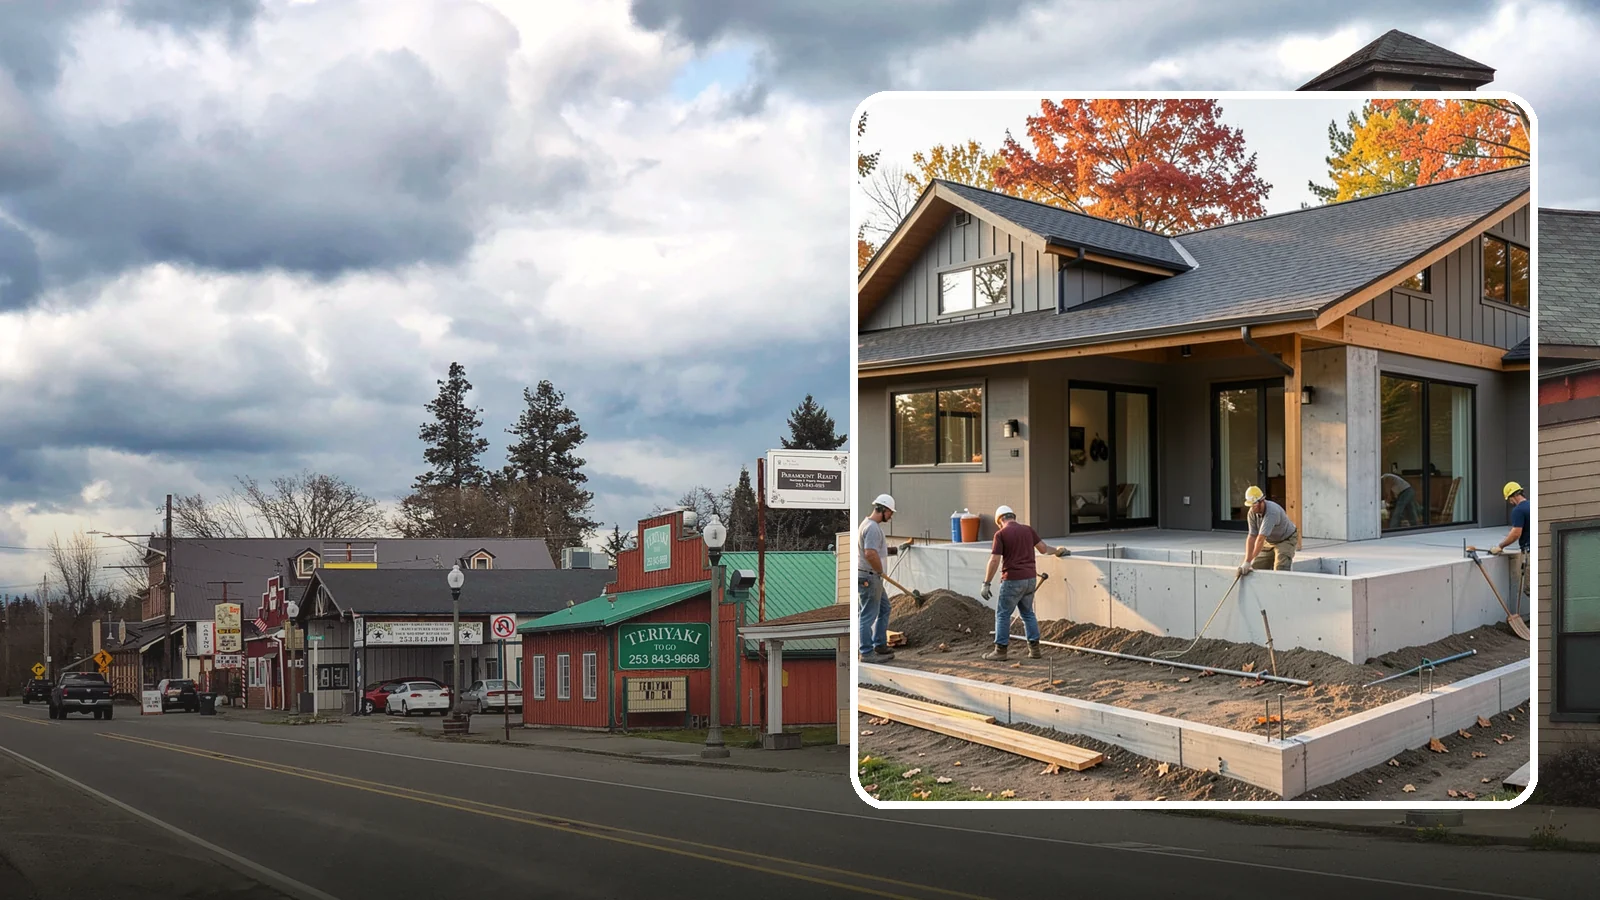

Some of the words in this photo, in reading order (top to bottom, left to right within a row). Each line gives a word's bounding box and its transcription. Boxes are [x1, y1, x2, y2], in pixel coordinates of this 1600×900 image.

[625, 627, 702, 645] TERIYAKI
[629, 655, 648, 664] 253
[651, 654, 700, 664] 843-9668
